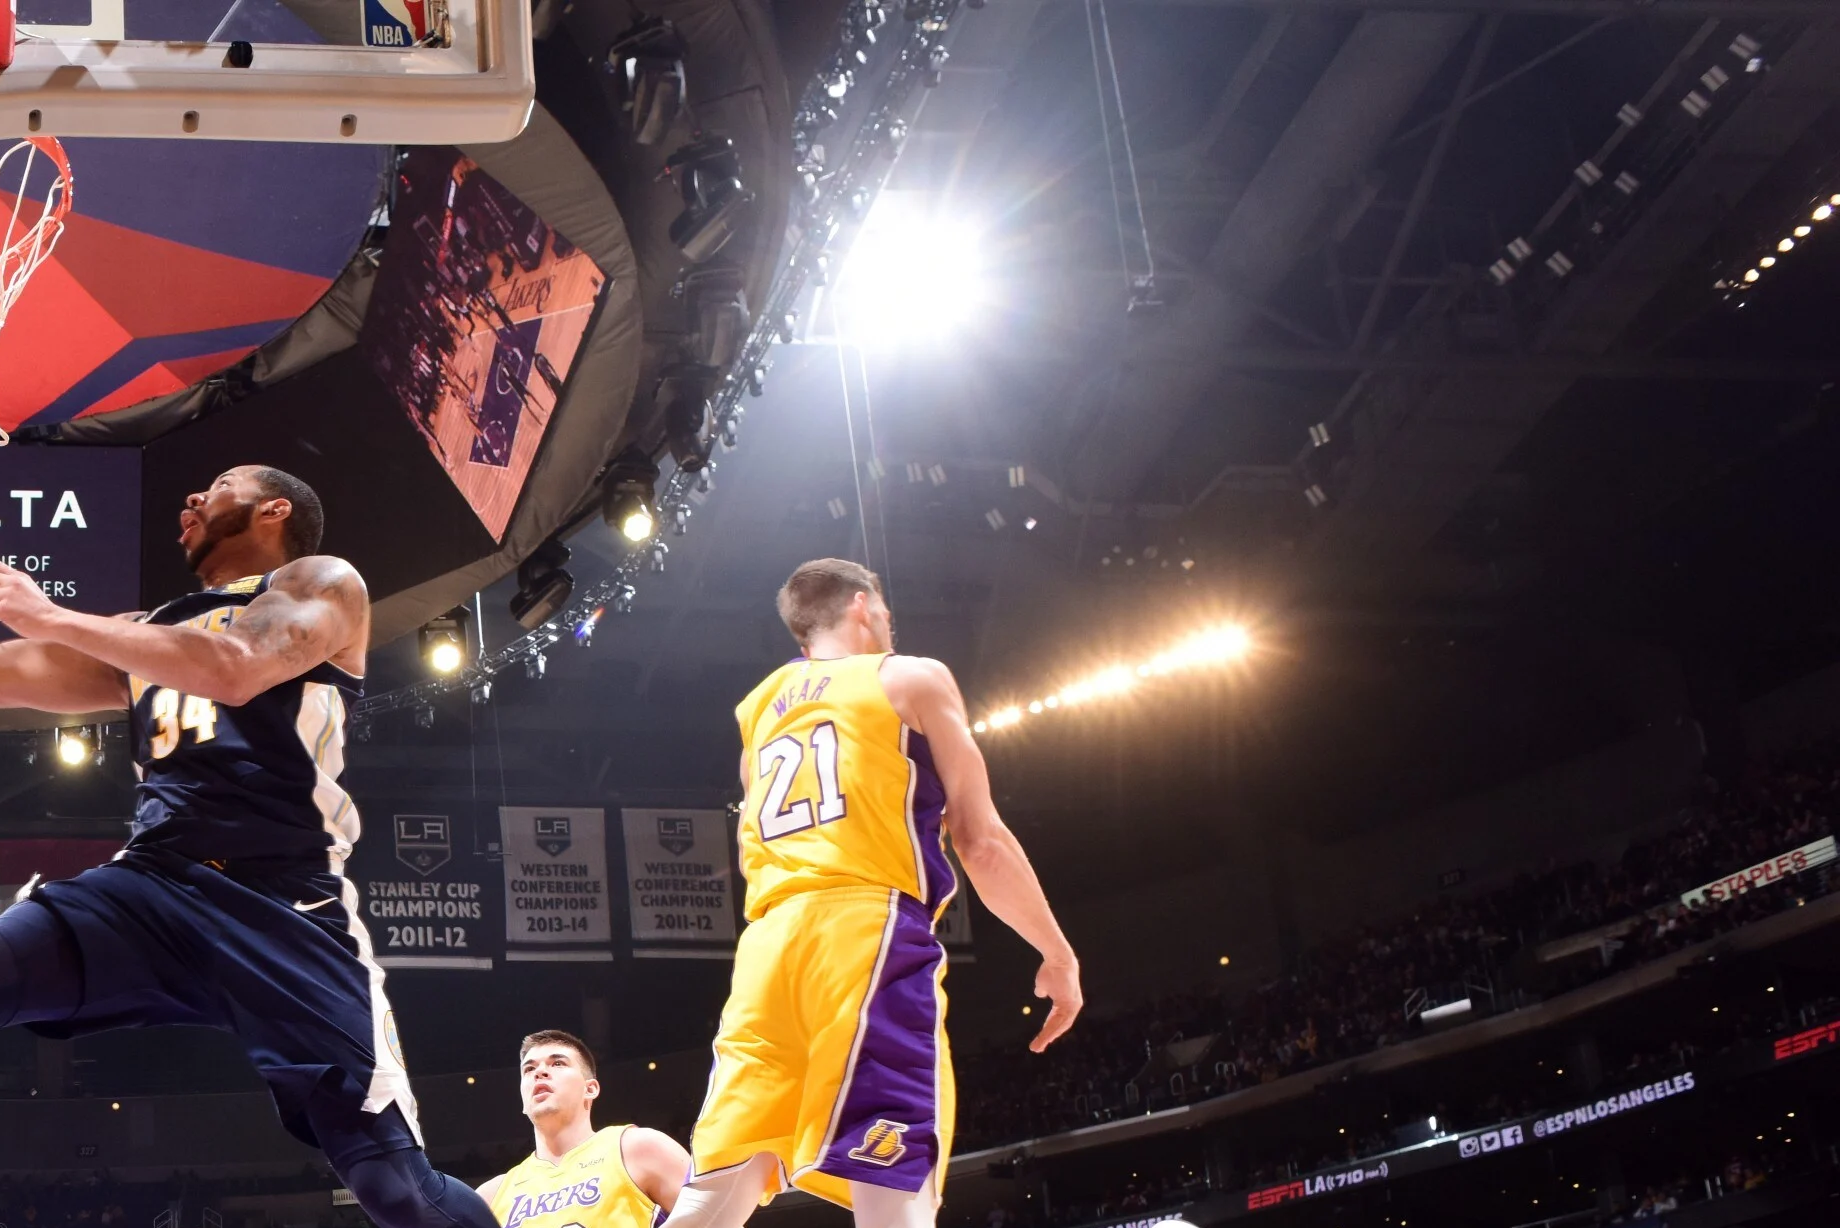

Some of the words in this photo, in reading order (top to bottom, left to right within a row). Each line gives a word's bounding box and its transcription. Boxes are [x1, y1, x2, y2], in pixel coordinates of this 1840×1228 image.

[372, 25, 405, 46] NBA
[24, 555, 51, 572] OF
[772, 676, 832, 719] WEAR
[151, 684, 217, 760] 34
[758, 720, 847, 843] 21
[398, 819, 446, 841] LA
[536, 818, 570, 835] LA
[520, 862, 589, 878] WESTERN
[645, 861, 713, 877] WESTERN
[1709, 850, 1809, 902] STAPLES
[368, 880, 441, 899] STANLEY
[446, 882, 482, 900] CUP
[510, 878, 602, 895] CONFERENCE
[634, 877, 726, 894] CONFERENCE
[368, 899, 483, 920] CHAMPIONS
[514, 895, 599, 911] CHAMPIONS
[639, 894, 723, 910] CHAMPIONS
[526, 915, 588, 933] 2013-14
[654, 913, 714, 932] 2011-12
[387, 926, 468, 948] 2011-12
[1532, 1071, 1696, 1140] @ESPNLOSANGELES
